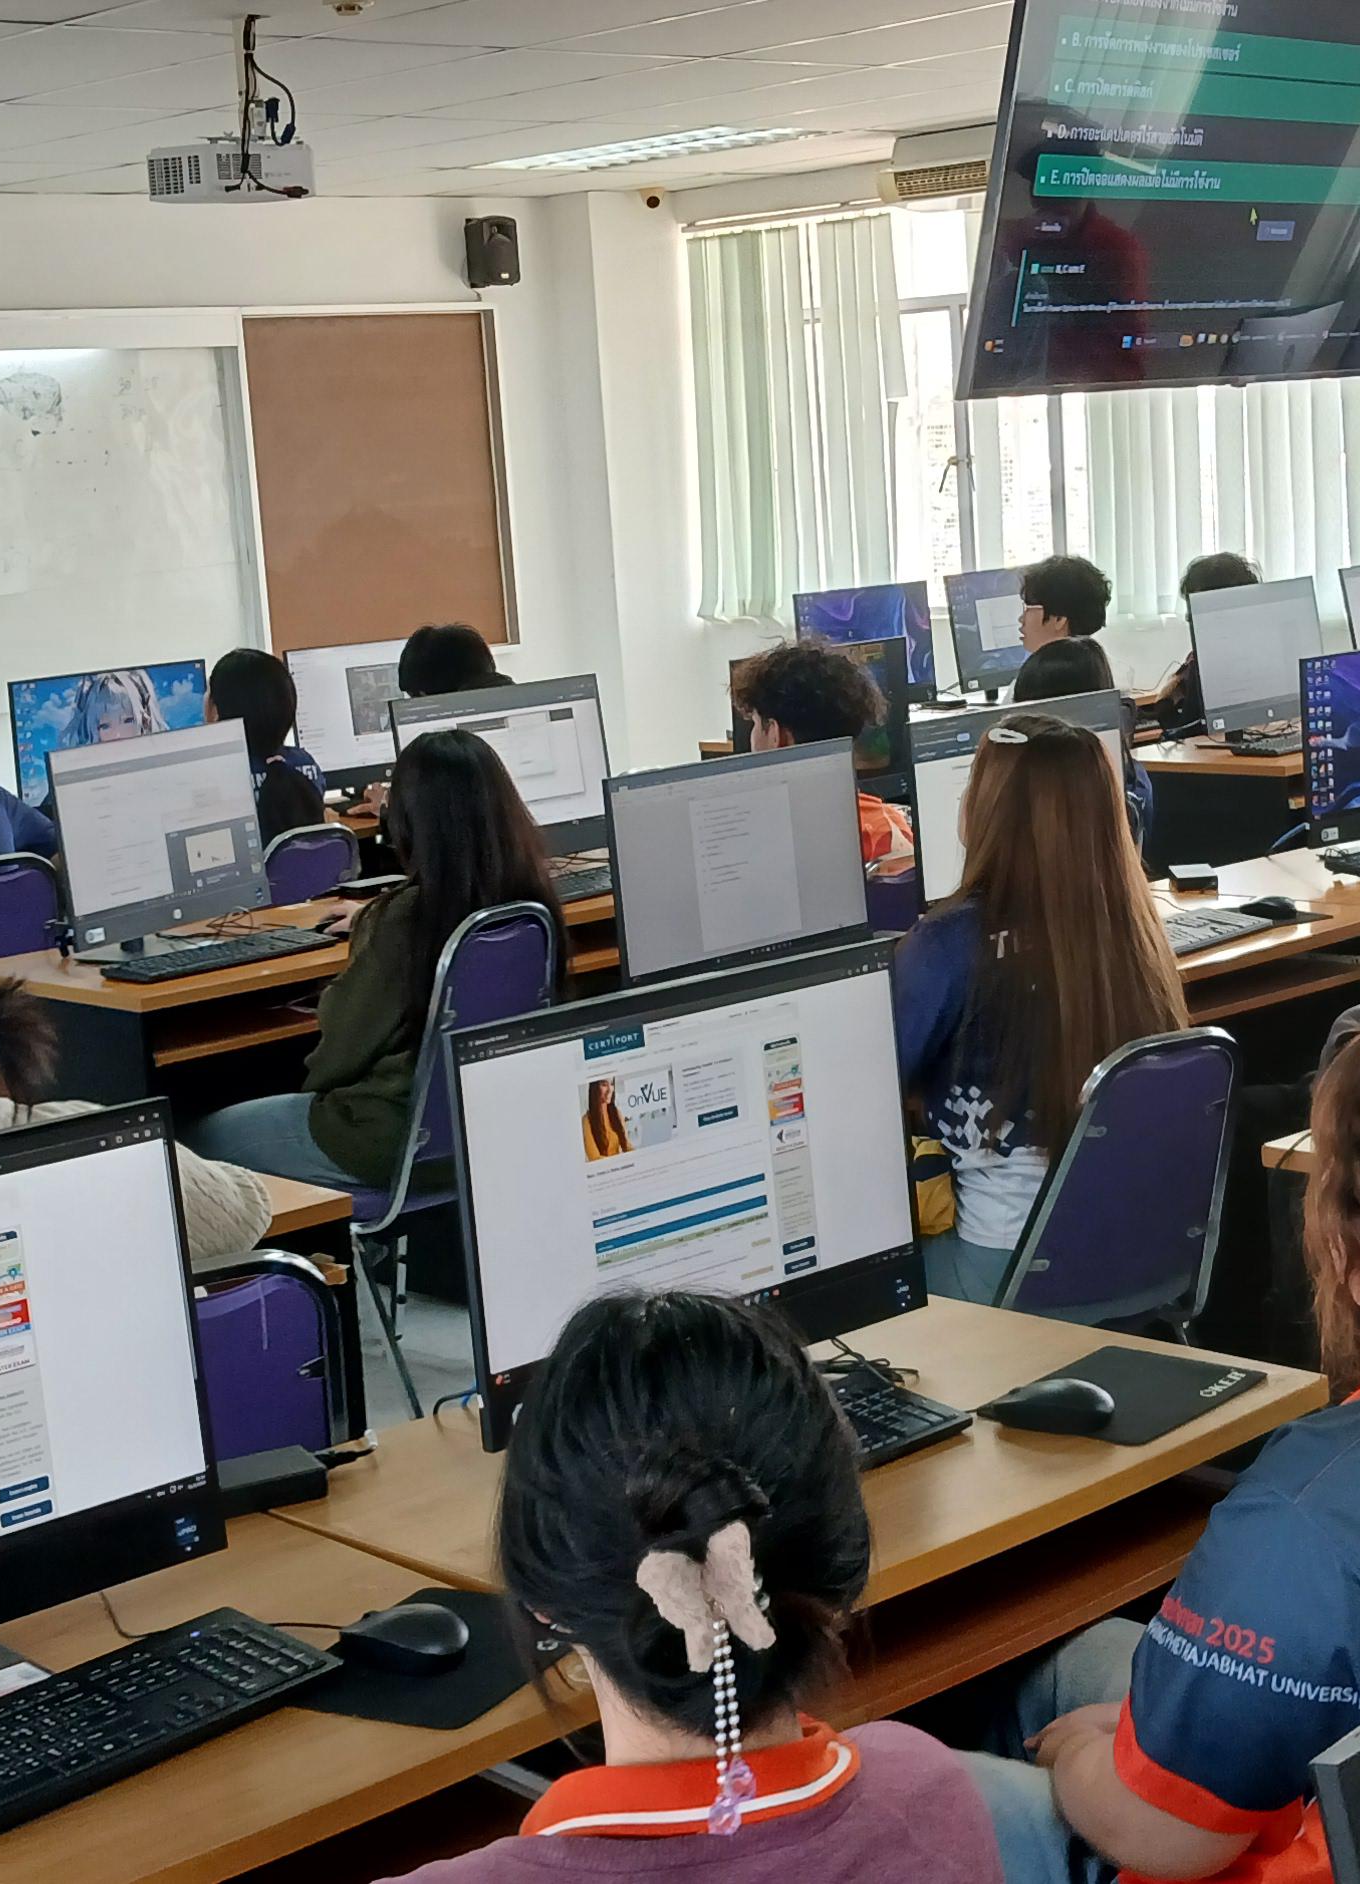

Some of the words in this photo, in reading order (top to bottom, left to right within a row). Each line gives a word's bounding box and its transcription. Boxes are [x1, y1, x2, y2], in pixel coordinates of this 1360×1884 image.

[1050, 171, 1060, 184] E.
[588, 1033, 640, 1051] CERTIPORT
[628, 1082, 668, 1107] OnVUE
[1199, 1369, 1246, 1399] OKER
[1206, 1615, 1276, 1664] 2025
